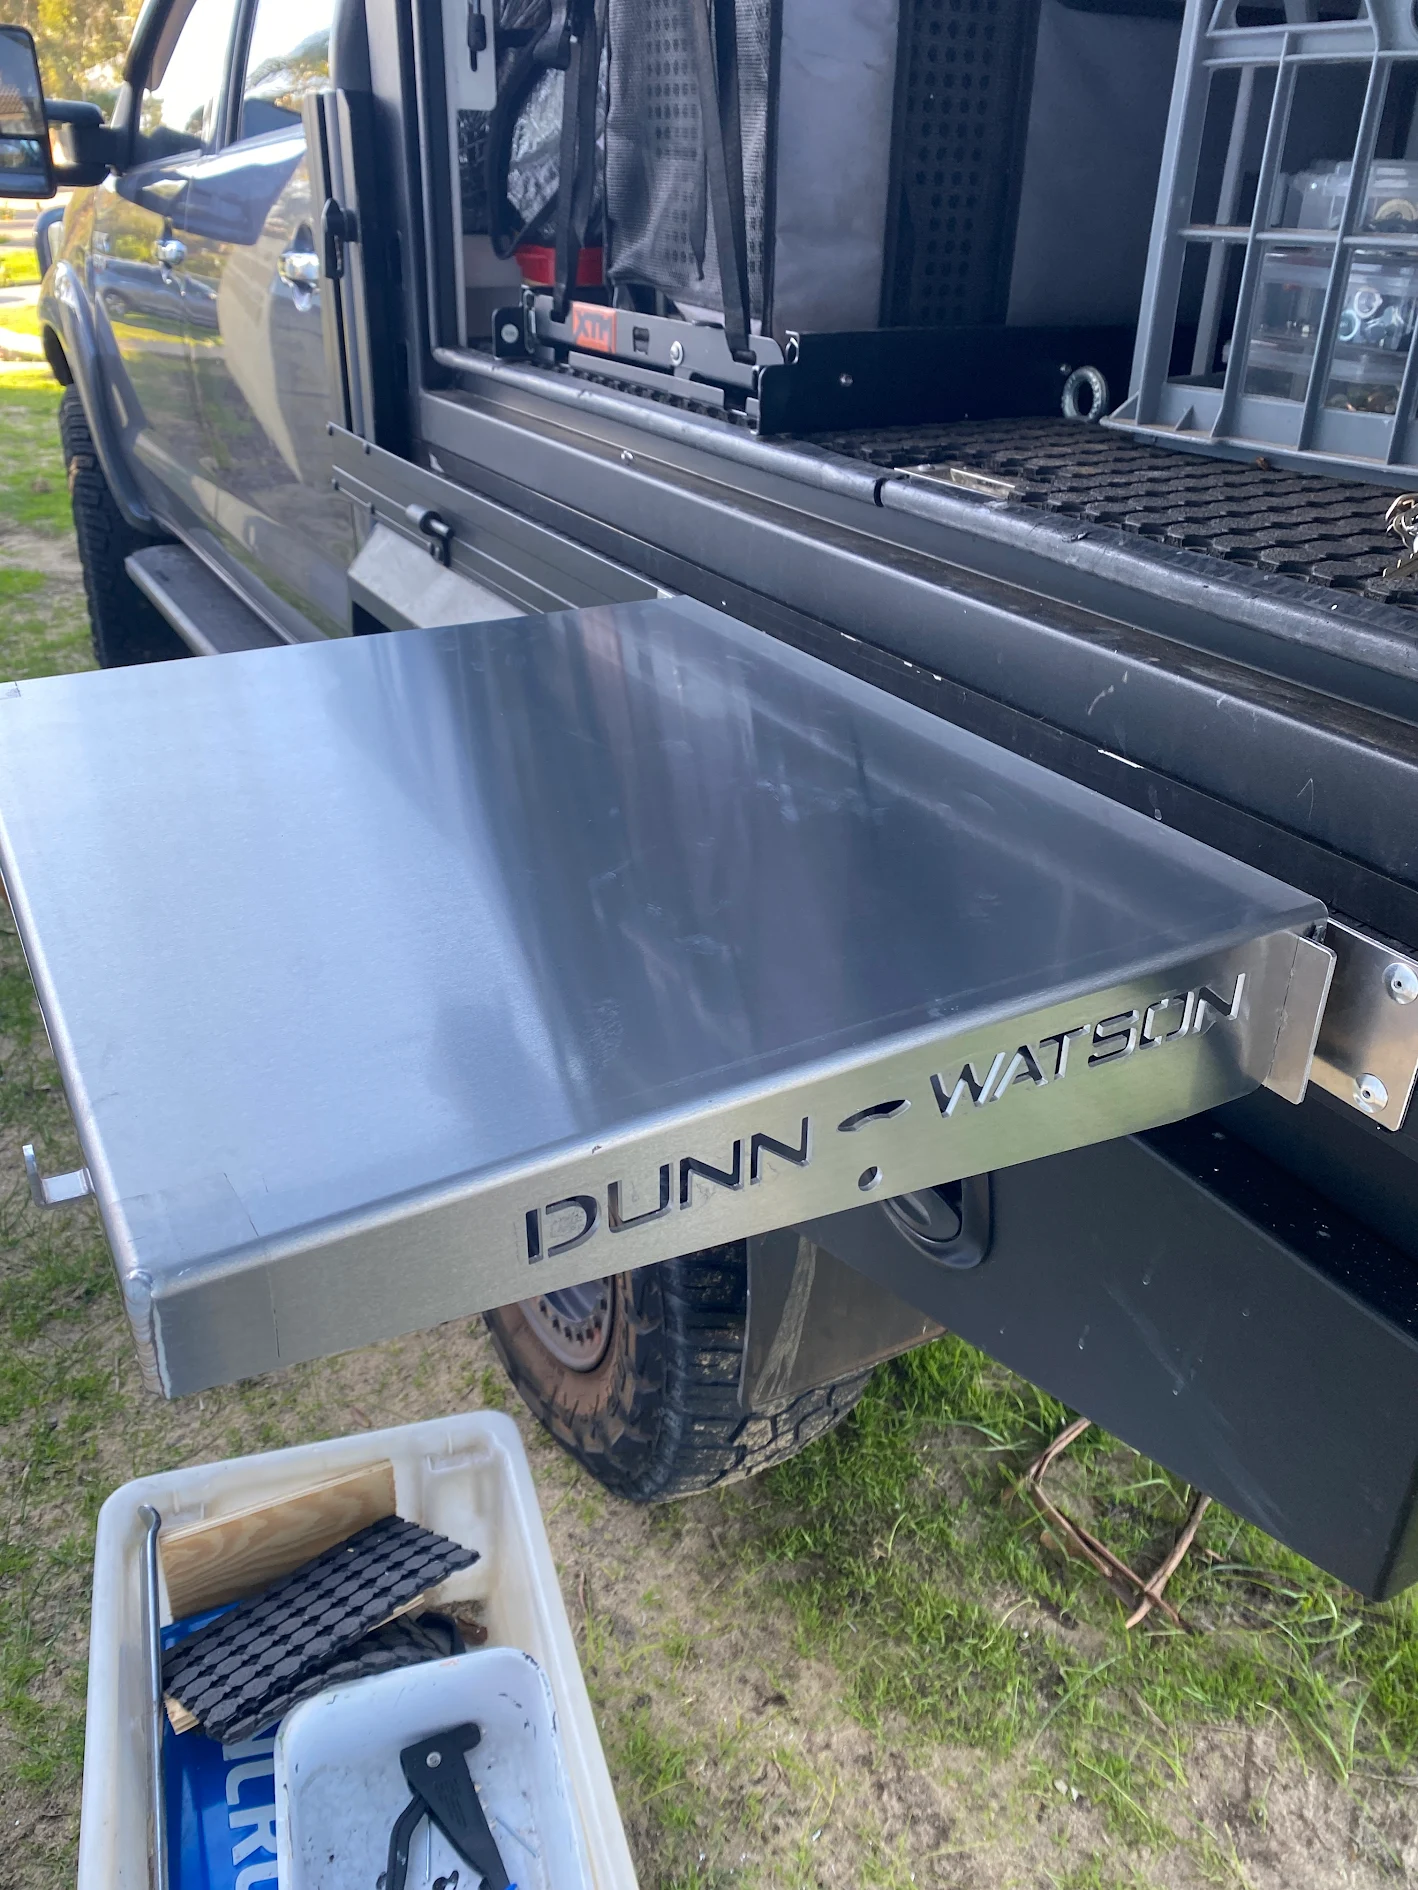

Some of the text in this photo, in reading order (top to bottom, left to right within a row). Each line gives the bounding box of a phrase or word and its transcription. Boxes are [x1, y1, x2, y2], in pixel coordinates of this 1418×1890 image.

[572, 308, 614, 353] XTM
[525, 972, 1246, 1265] DUNN WATSON
